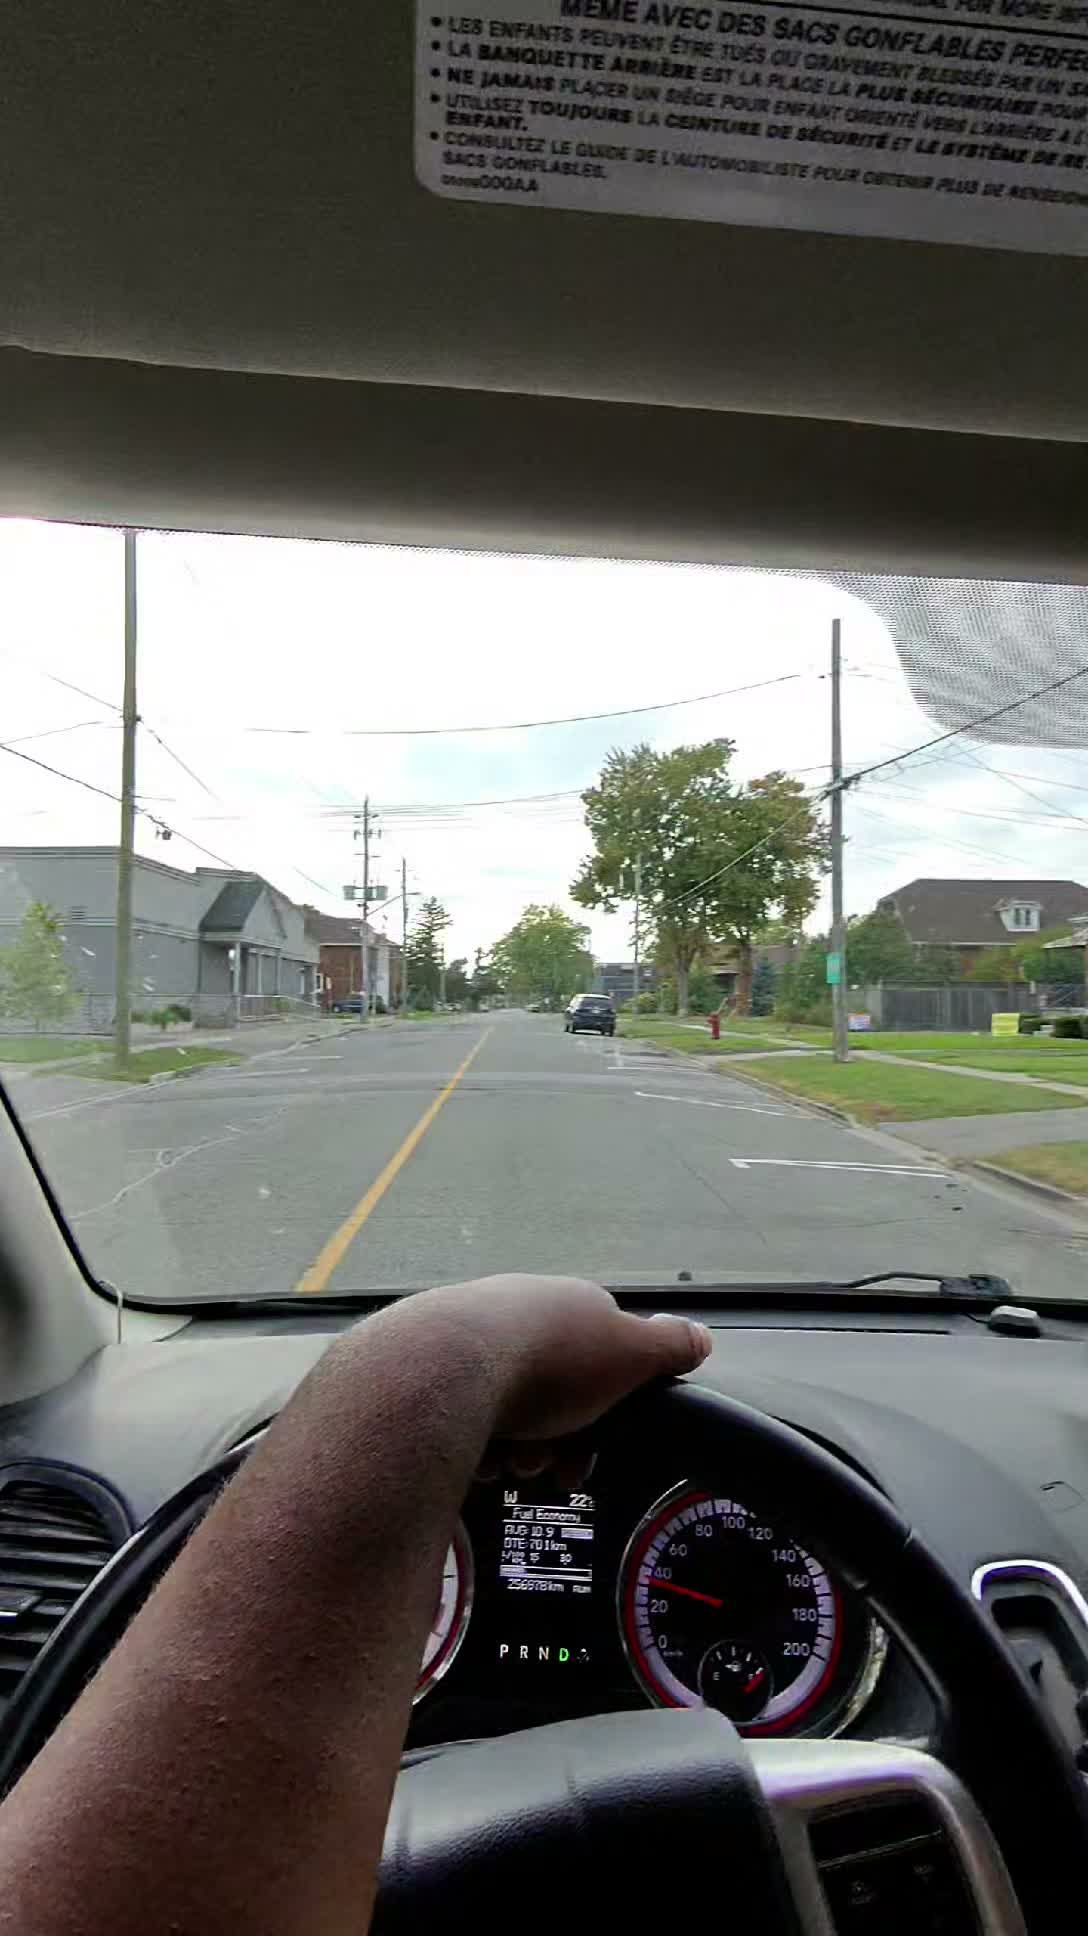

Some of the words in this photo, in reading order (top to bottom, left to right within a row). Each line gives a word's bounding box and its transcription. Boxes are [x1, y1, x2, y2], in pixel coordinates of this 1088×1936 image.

[447, 16, 482, 35] LES
[489, 20, 574, 43] ENFANTS
[578, 29, 667, 52] PEUVENT
[642, 3, 713, 31] AVEC
[716, 11, 767, 37] DES
[772, 17, 840, 45] SACS
[844, 25, 1007, 62] GONFLABLES
[447, 40, 473, 58] LA
[478, 43, 605, 71] BANQUETTE
[701, 66, 735, 86] EST
[739, 71, 763, 88] LA
[767, 73, 825, 94] PLACE
[855, 83, 909, 102] PLUS
[447, 67, 474, 86] NE
[481, 71, 556, 92] JAMAIS
[560, 78, 629, 98] PLACER
[720, 95, 770, 113] POUR
[446, 93, 524, 114] UTILISEZ
[527, 100, 632, 123] TOUJOURS
[637, 109, 660, 127] LA
[664, 113, 762, 137] CEINTURE
[766, 125, 793, 140] DE
[446, 110, 528, 132] ENFANT.
[443, 131, 546, 153] CONSULTEZ
[551, 140, 571, 156] LE
[443, 151, 486, 169] SACS
[512, 1507, 534, 1520] Fuel
[536, 1508, 581, 1524] Economy
[721, 1516, 746, 1530] 100
[695, 1524, 713, 1537] 80
[749, 1528, 774, 1541] 120
[669, 1544, 688, 1557] 60
[771, 1550, 797, 1563] 140
[653, 1566, 672, 1579] 40
[786, 1574, 811, 1588] 160
[650, 1600, 669, 1614] 20
[792, 1608, 817, 1622] 180
[658, 1635, 667, 1649] 0
[783, 1642, 811, 1656] 200
[500, 1644, 509, 1659] P
[520, 1645, 529, 1659] R
[539, 1647, 549, 1661] N
[559, 1648, 570, 1662] D
